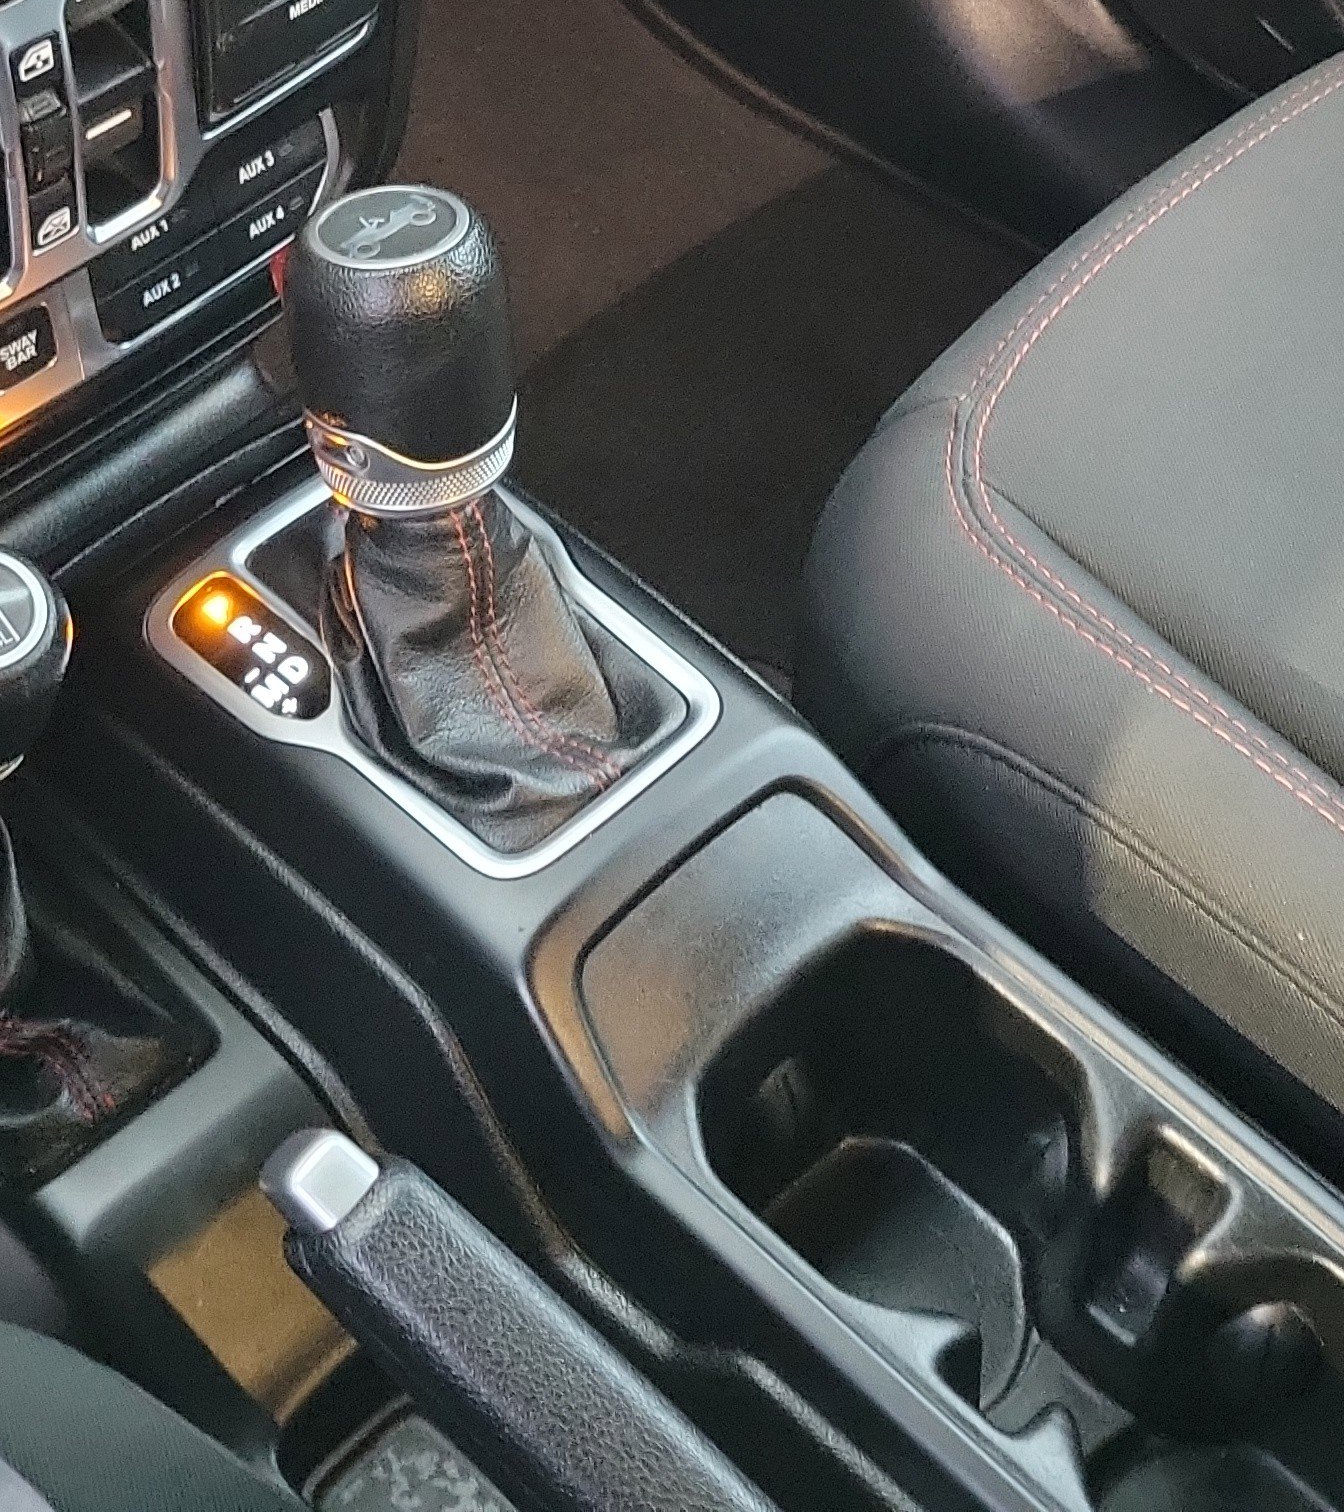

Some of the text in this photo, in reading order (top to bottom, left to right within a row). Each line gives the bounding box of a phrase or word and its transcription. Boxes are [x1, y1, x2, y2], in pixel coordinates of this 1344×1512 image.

[238, 149, 275, 185] AUX 3
[131, 226, 159, 252] AUX
[248, 206, 285, 241] AUX 4
[142, 272, 181, 308] AUX 2
[6, 344, 38, 371] BAR
[227, 615, 262, 644] R
[251, 632, 287, 664] N
[277, 655, 309, 685] D
